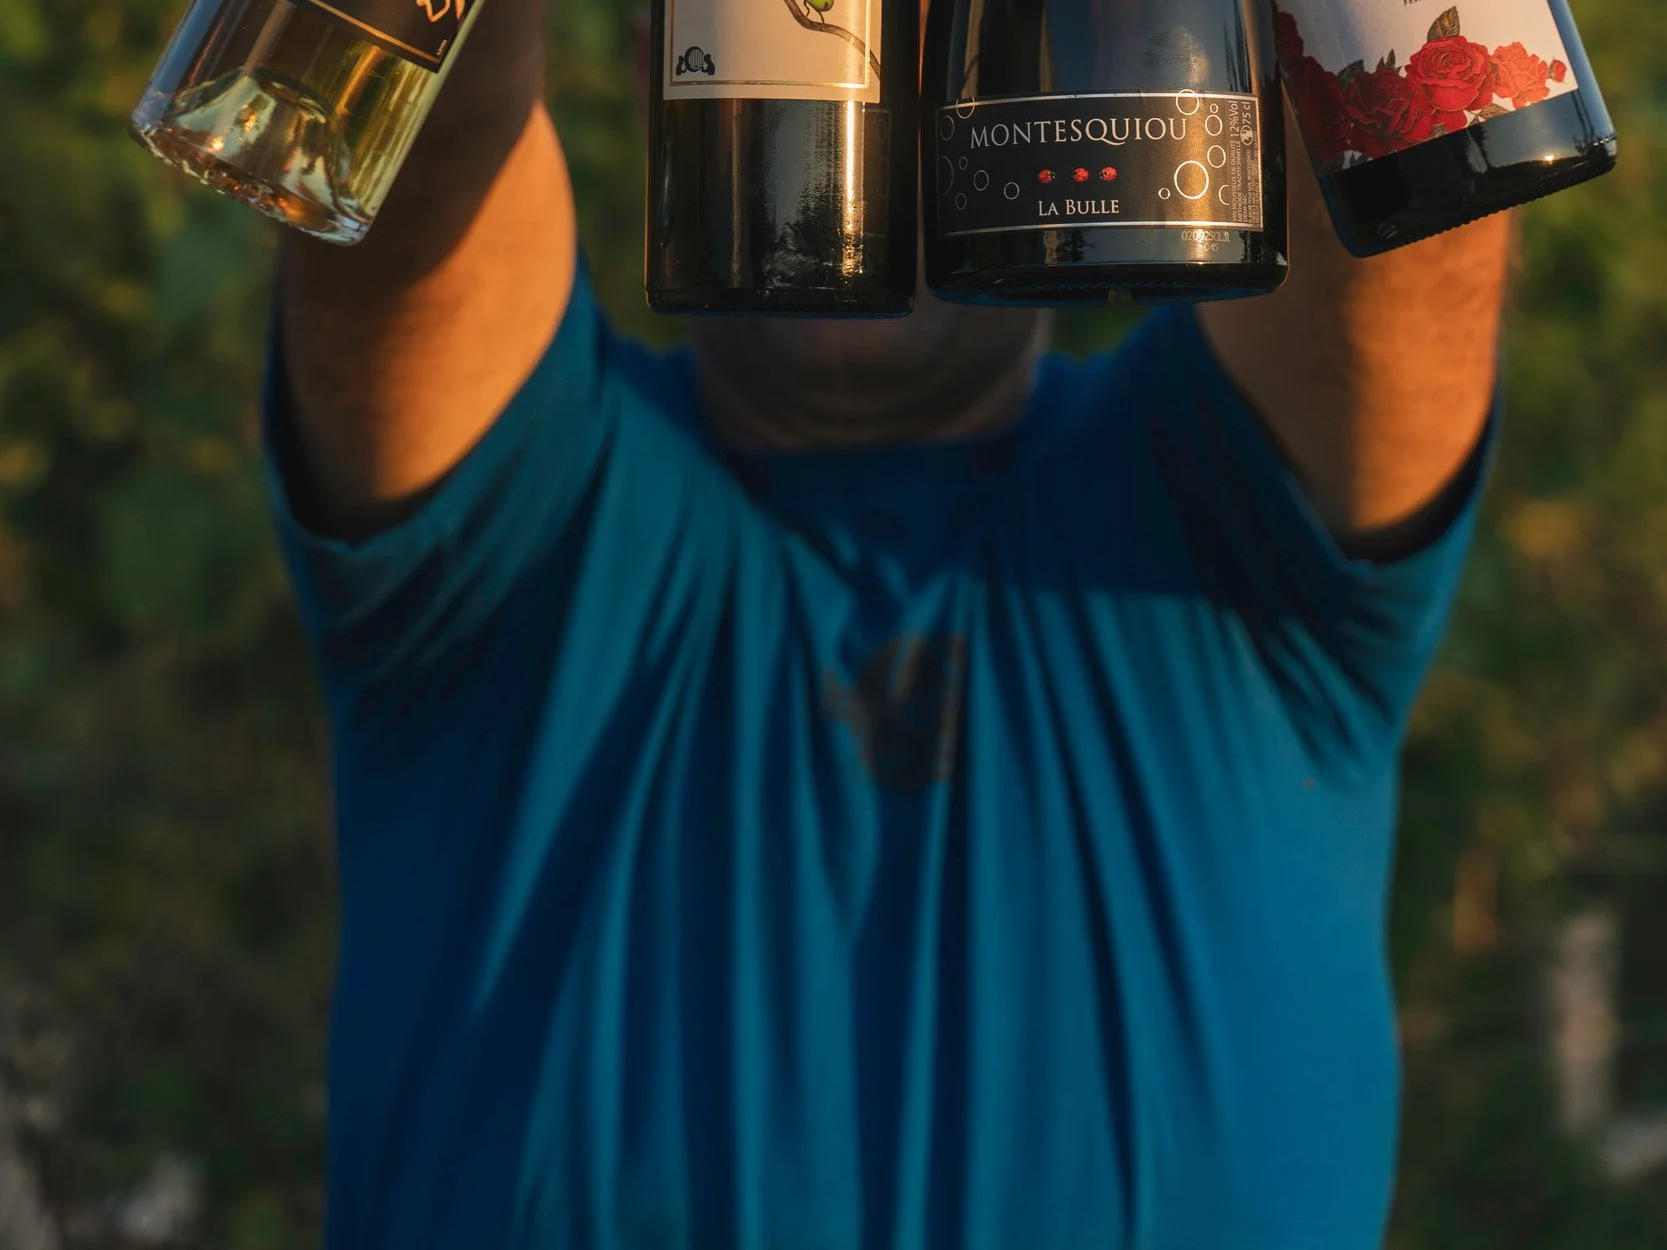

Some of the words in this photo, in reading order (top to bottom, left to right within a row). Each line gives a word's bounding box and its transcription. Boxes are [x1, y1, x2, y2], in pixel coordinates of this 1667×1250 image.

[1242, 112, 1251, 124] 75
[970, 117, 1187, 149] MONTESQUIOU
[1038, 200, 1060, 216] LA
[1065, 199, 1120, 215] BULLE
